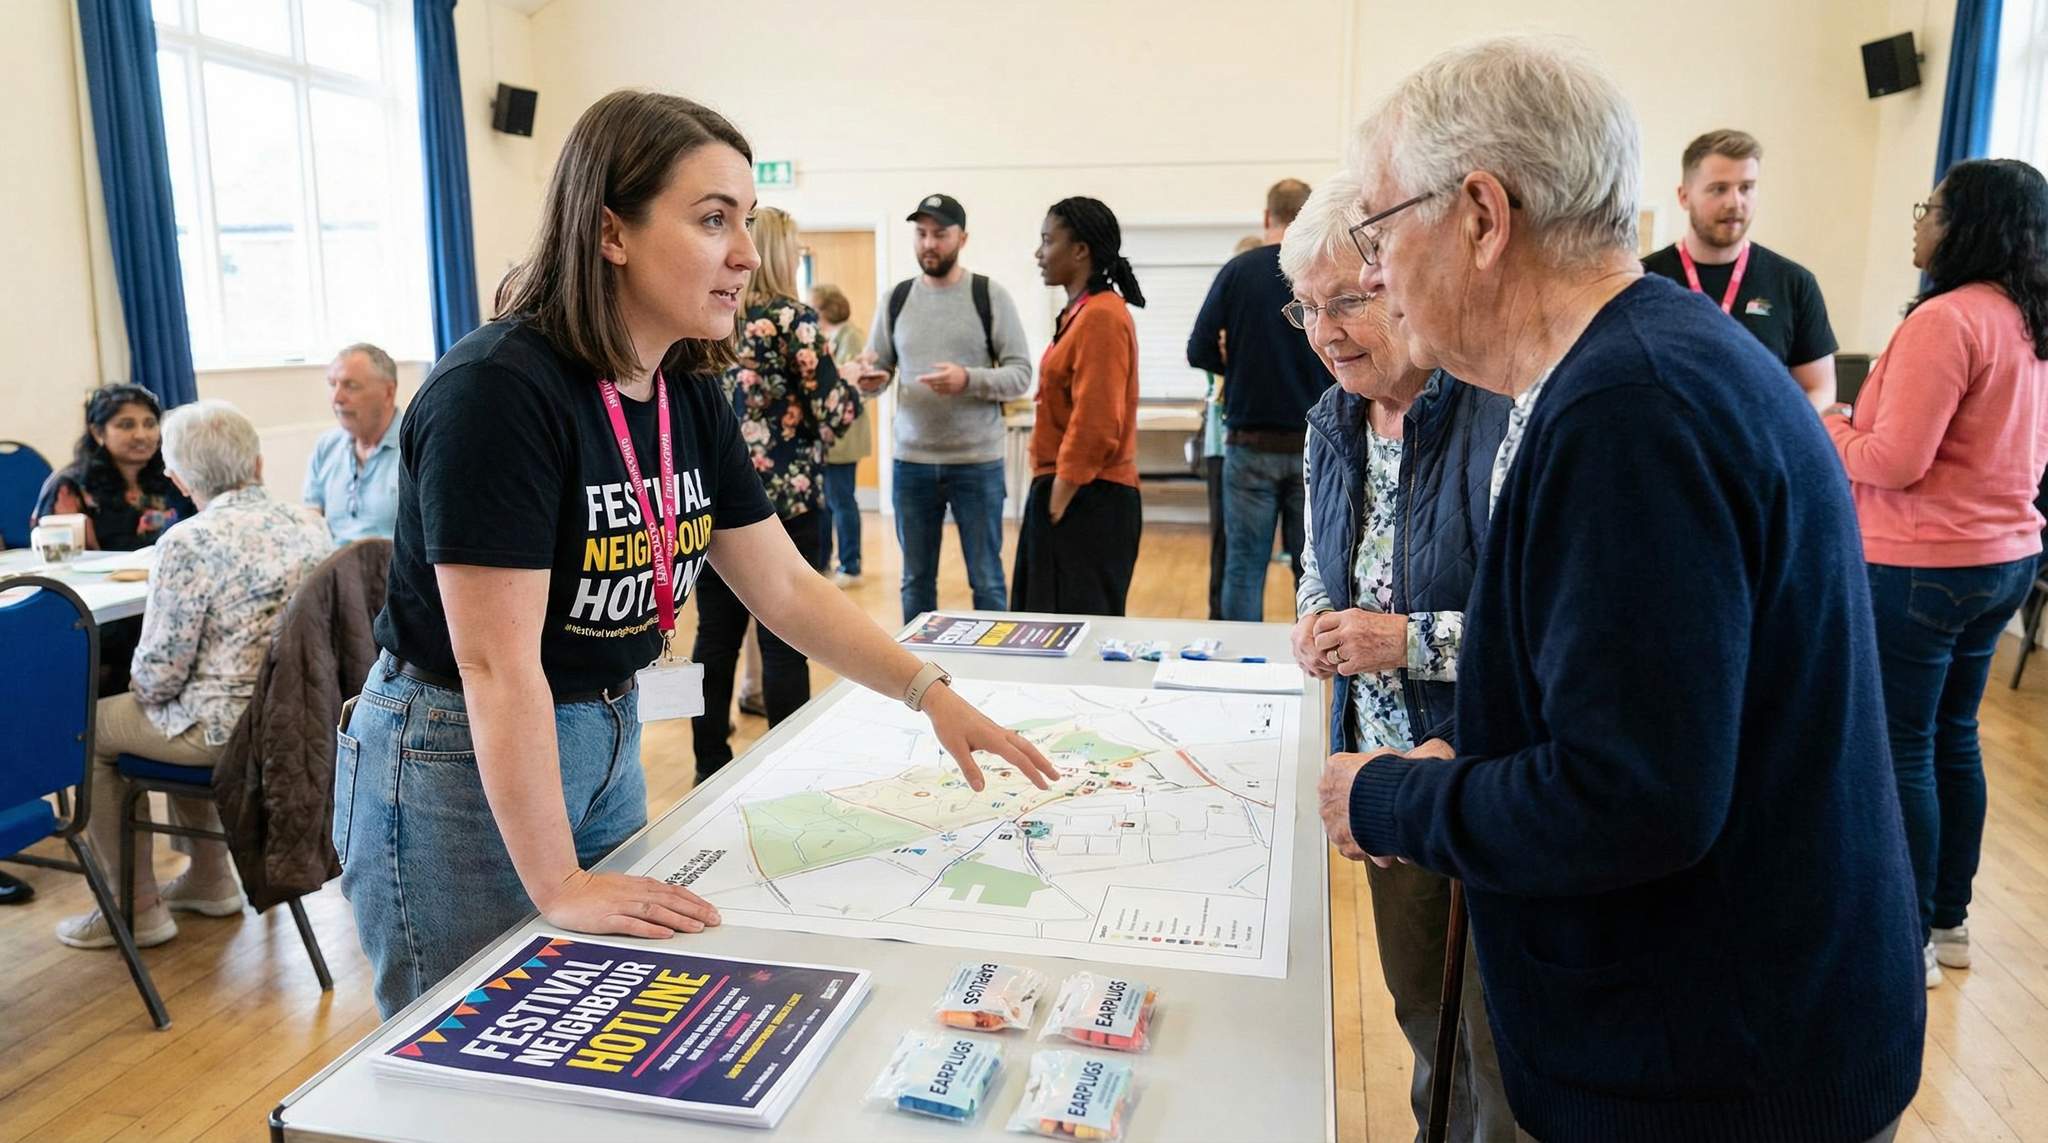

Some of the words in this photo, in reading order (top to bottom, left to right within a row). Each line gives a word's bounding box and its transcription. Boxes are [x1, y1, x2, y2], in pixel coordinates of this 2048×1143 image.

[459, 959, 615, 1060] FESTIVAL
[963, 963, 998, 1005] EARPLUGS
[1095, 980, 1127, 1027] EARPLUGS
[513, 961, 657, 1067] NEIGHBOUR
[566, 969, 711, 1073] HOTLINE
[929, 1040, 974, 1096] EARPLUGS
[1067, 1060, 1104, 1117] EARPLUGS
